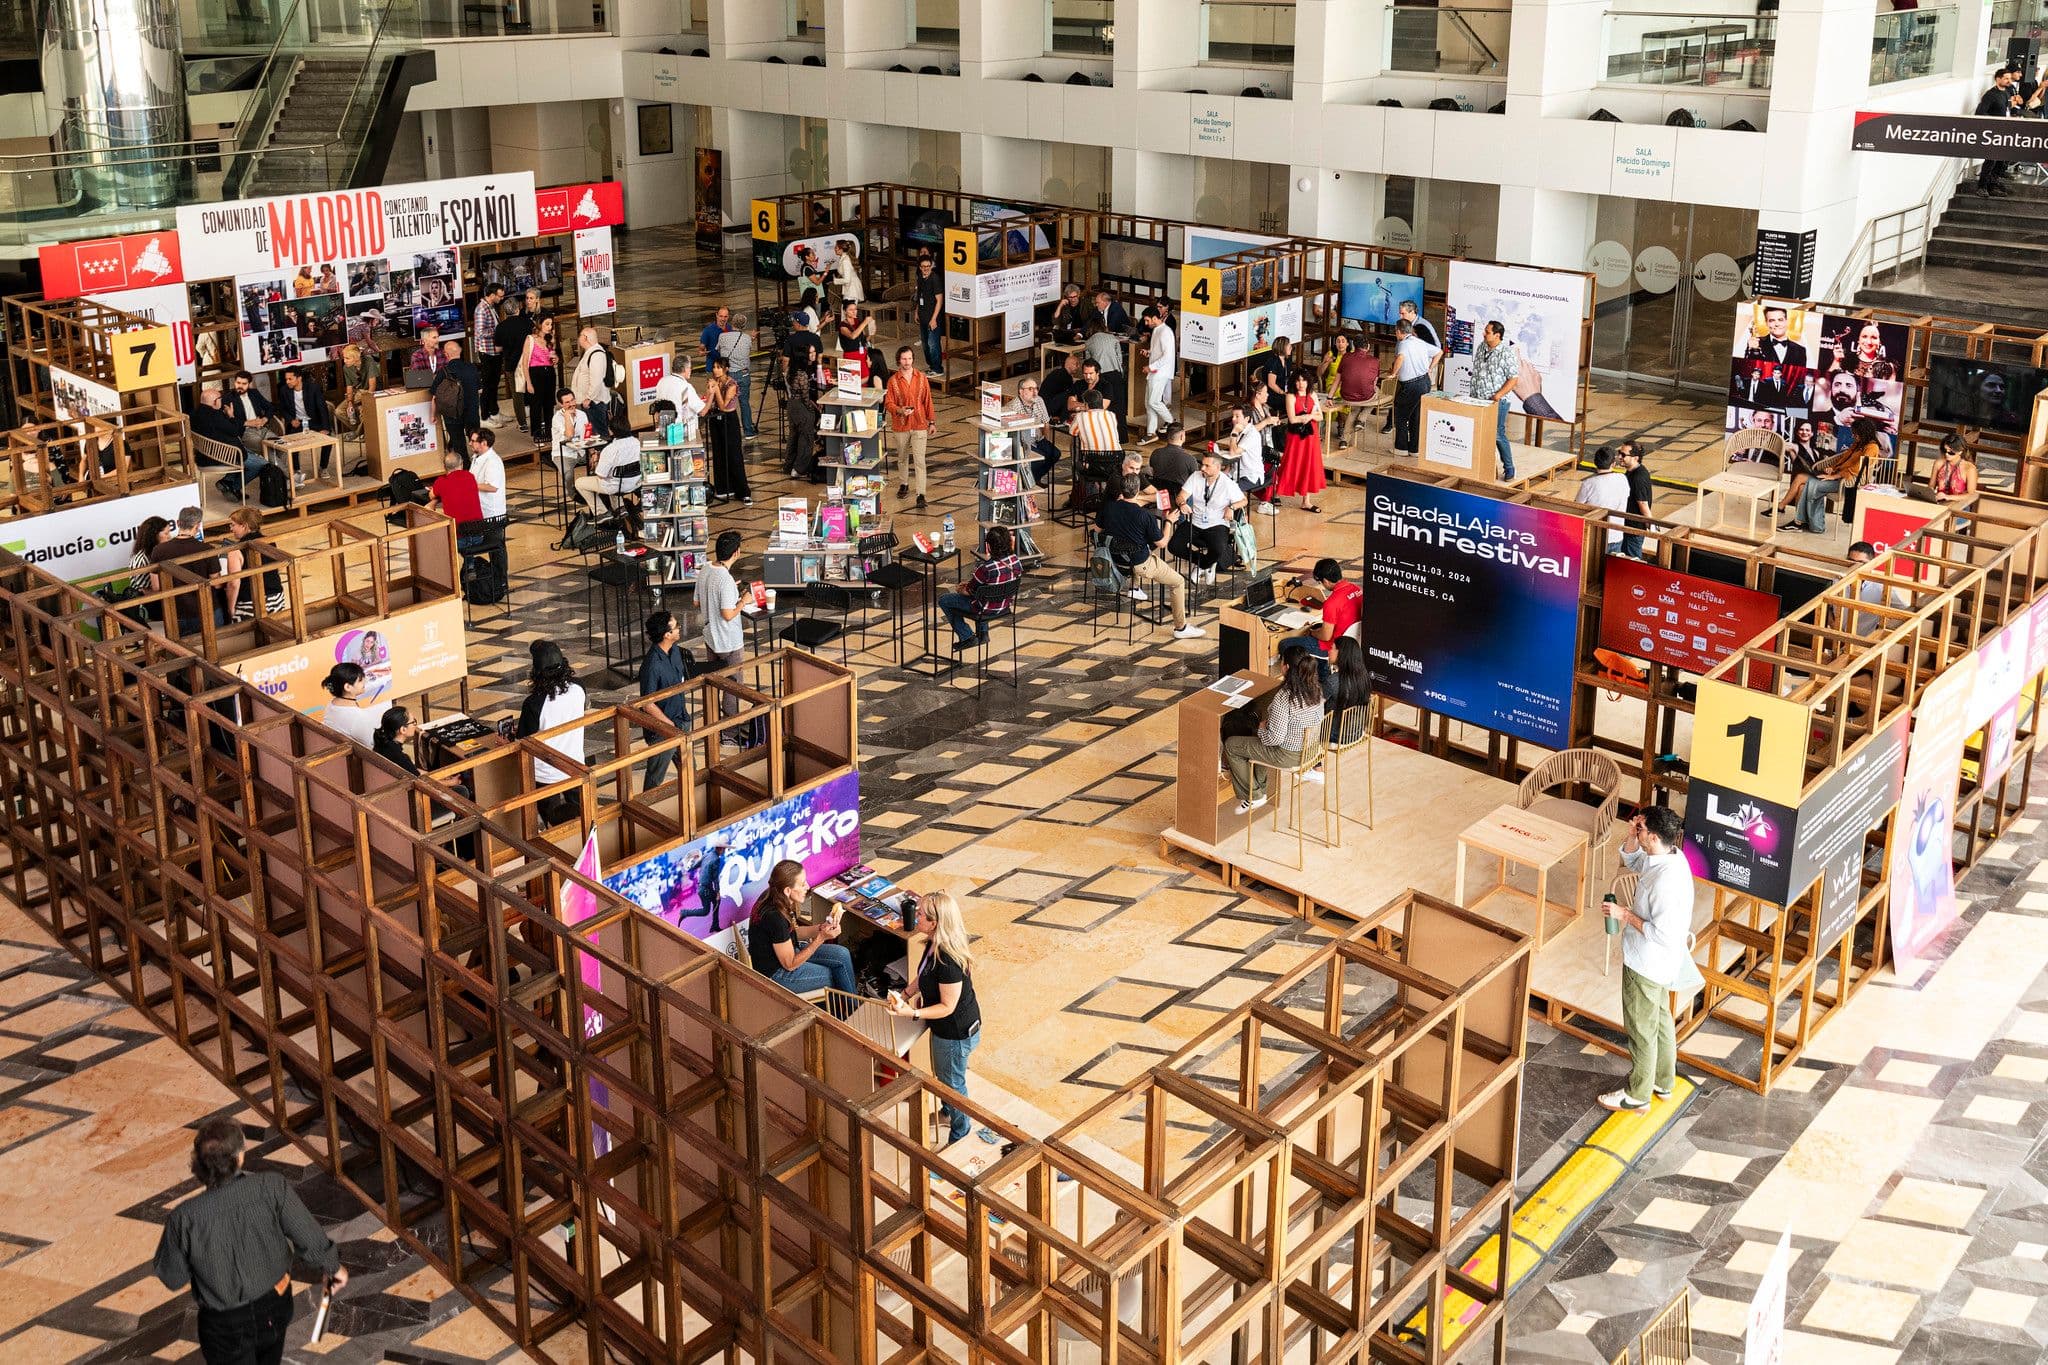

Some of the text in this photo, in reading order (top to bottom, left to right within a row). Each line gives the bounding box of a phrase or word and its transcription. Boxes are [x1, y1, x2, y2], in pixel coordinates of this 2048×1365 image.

[1885, 124, 1977, 144] Mezzanine
[1616, 156, 1671, 168] Plácido Domingo
[1635, 148, 1652, 156] SALA
[1624, 167, 1646, 175] Acceso
[384, 196, 429, 216] CONECTANDO
[440, 185, 521, 246] ESPAÑOL
[202, 206, 267, 235] COMUNIDAD
[267, 190, 386, 268] MADRID
[390, 213, 440, 239] TALENTO EN
[758, 210, 770, 233] 6
[256, 231, 269, 253] DE
[952, 240, 967, 266] 5
[583, 253, 610, 274] MADRID
[1190, 278, 1210, 305] 4
[1498, 288, 1531, 298] CONTENIDO
[1531, 293, 1569, 303] AUDIOVISUAL
[130, 343, 156, 377] 7
[781, 511, 799, 522] 15%
[1373, 494, 1537, 548] GuadaLAjara
[1372, 512, 1570, 578] Film Festival
[1372, 563, 1427, 584] DOWNTOWN
[1373, 553, 1397, 565] 11.01
[1416, 563, 1445, 578] 11.03,
[1448, 571, 1471, 584] 2024
[1372, 574, 1455, 603] LOS ANGELES, CA
[1430, 691, 1447, 701] FICG
[1497, 681, 1560, 704] VISIT OUR WEBSITE
[1513, 709, 1558, 727] SOCIAL MEDIA
[1726, 716, 1764, 776] 1
[791, 806, 811, 825] QUE
